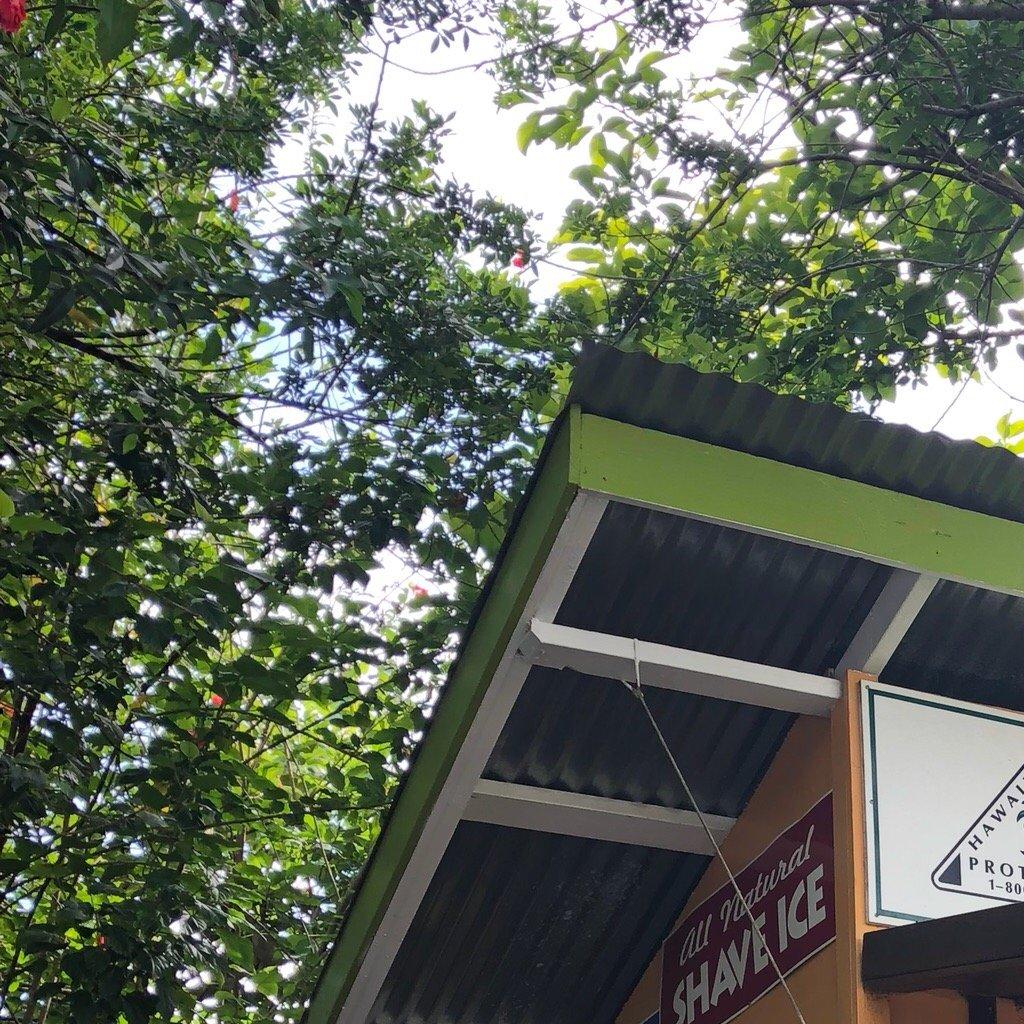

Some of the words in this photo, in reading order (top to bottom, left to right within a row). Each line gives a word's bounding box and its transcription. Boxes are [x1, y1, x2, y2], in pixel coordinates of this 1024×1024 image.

[680, 912, 713, 966] All
[720, 825, 814, 929] Natural
[779, 863, 826, 954] ICE
